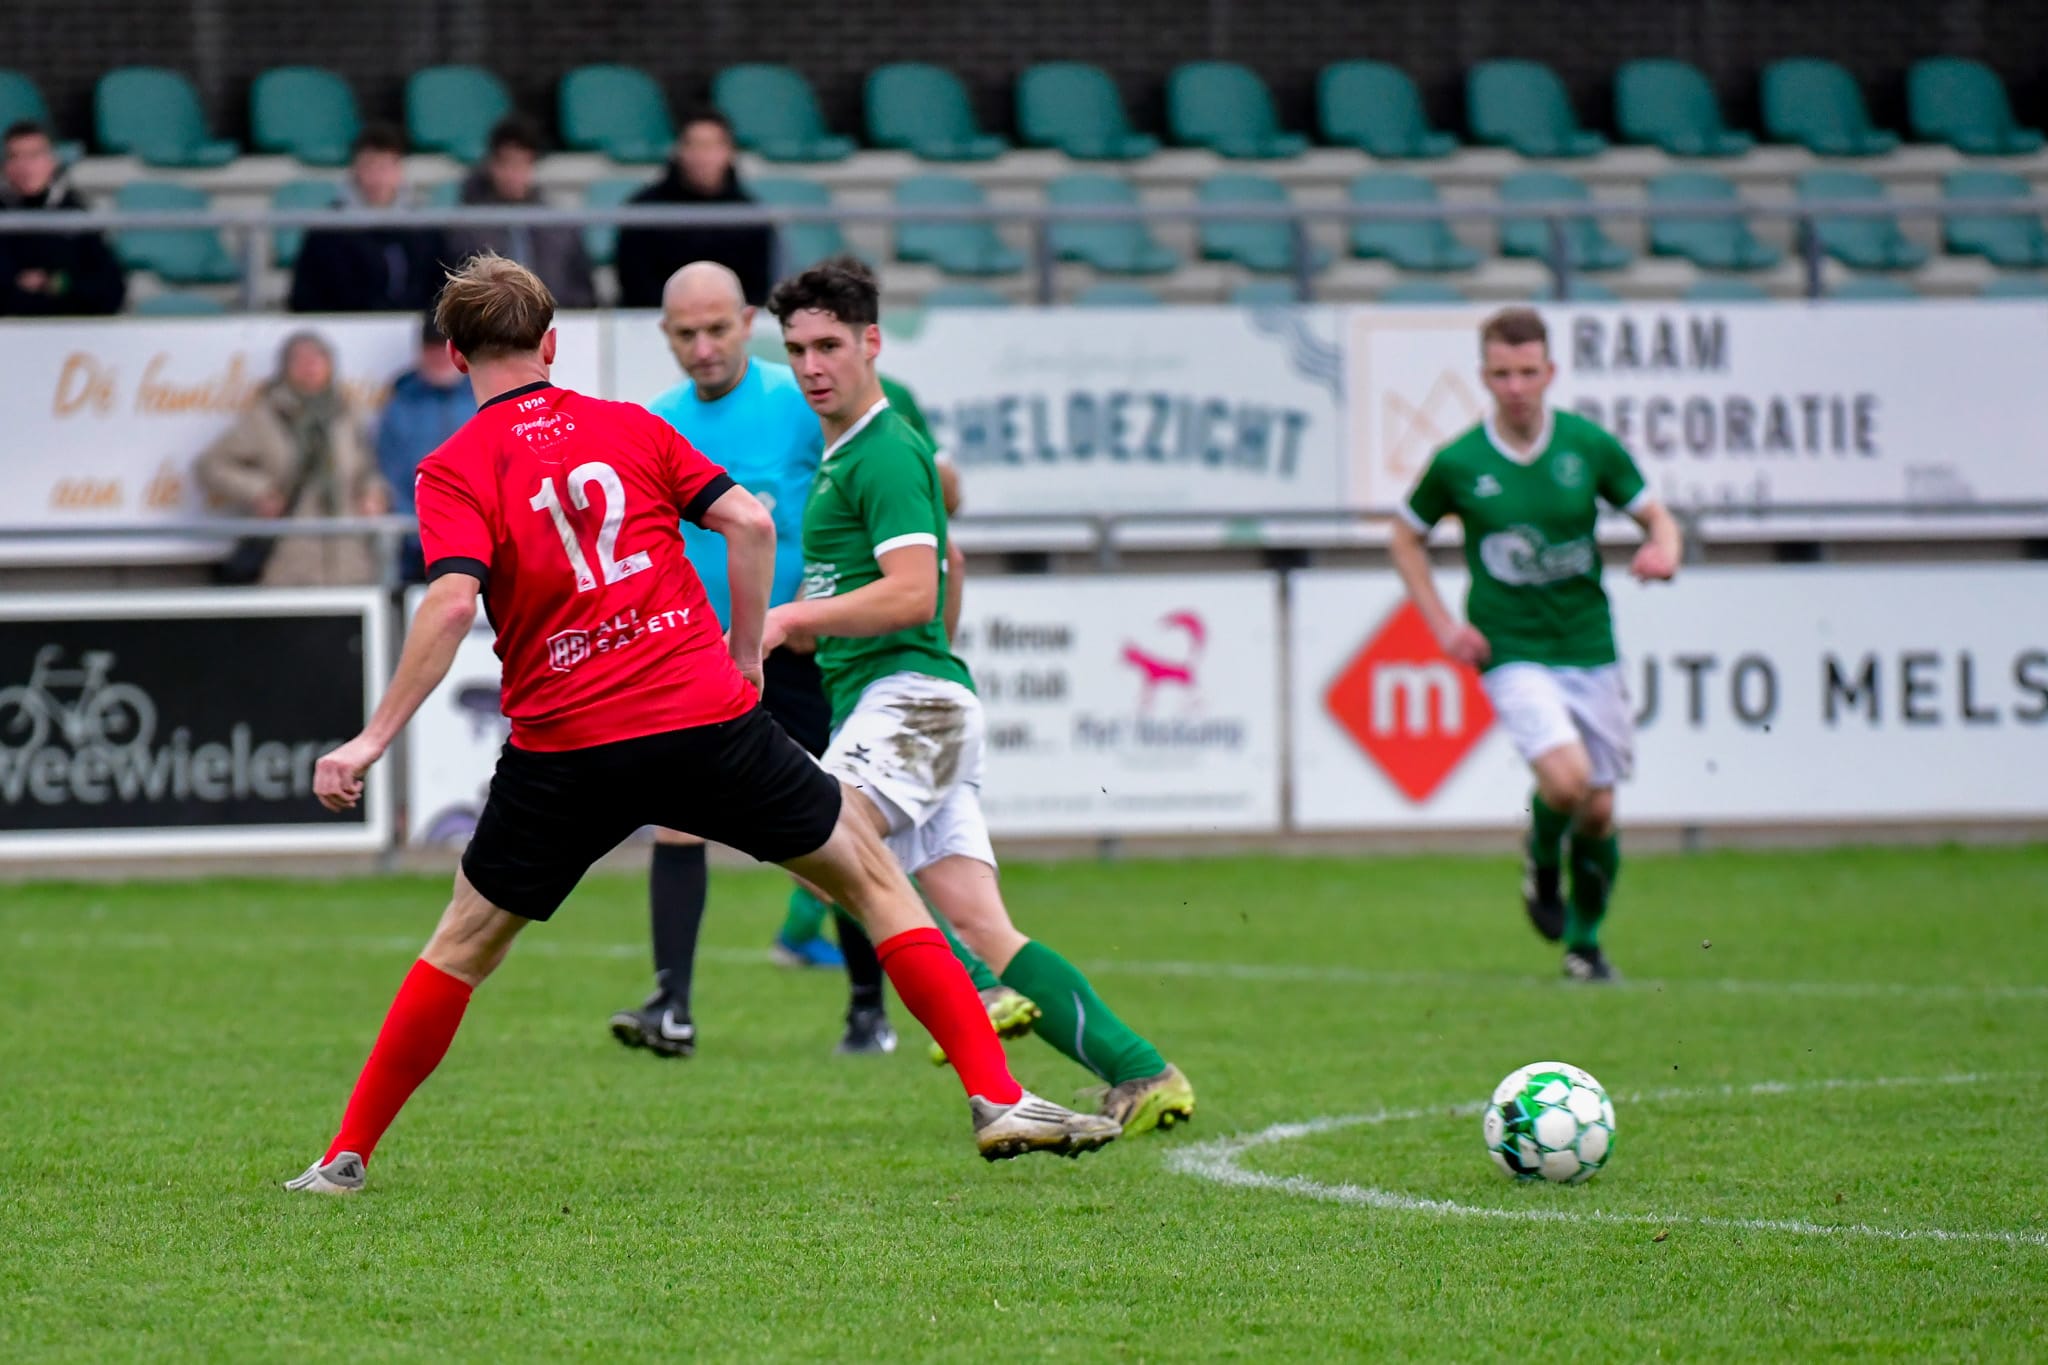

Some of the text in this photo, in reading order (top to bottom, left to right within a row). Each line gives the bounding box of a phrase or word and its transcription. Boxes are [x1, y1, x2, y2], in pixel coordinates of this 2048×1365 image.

[1573, 316, 1730, 372] RAAM
[528, 461, 653, 593] 12
[596, 608, 640, 637] ALL
[596, 607, 690, 653] SAFETY
[1632, 649, 2048, 727] UTO MELS
